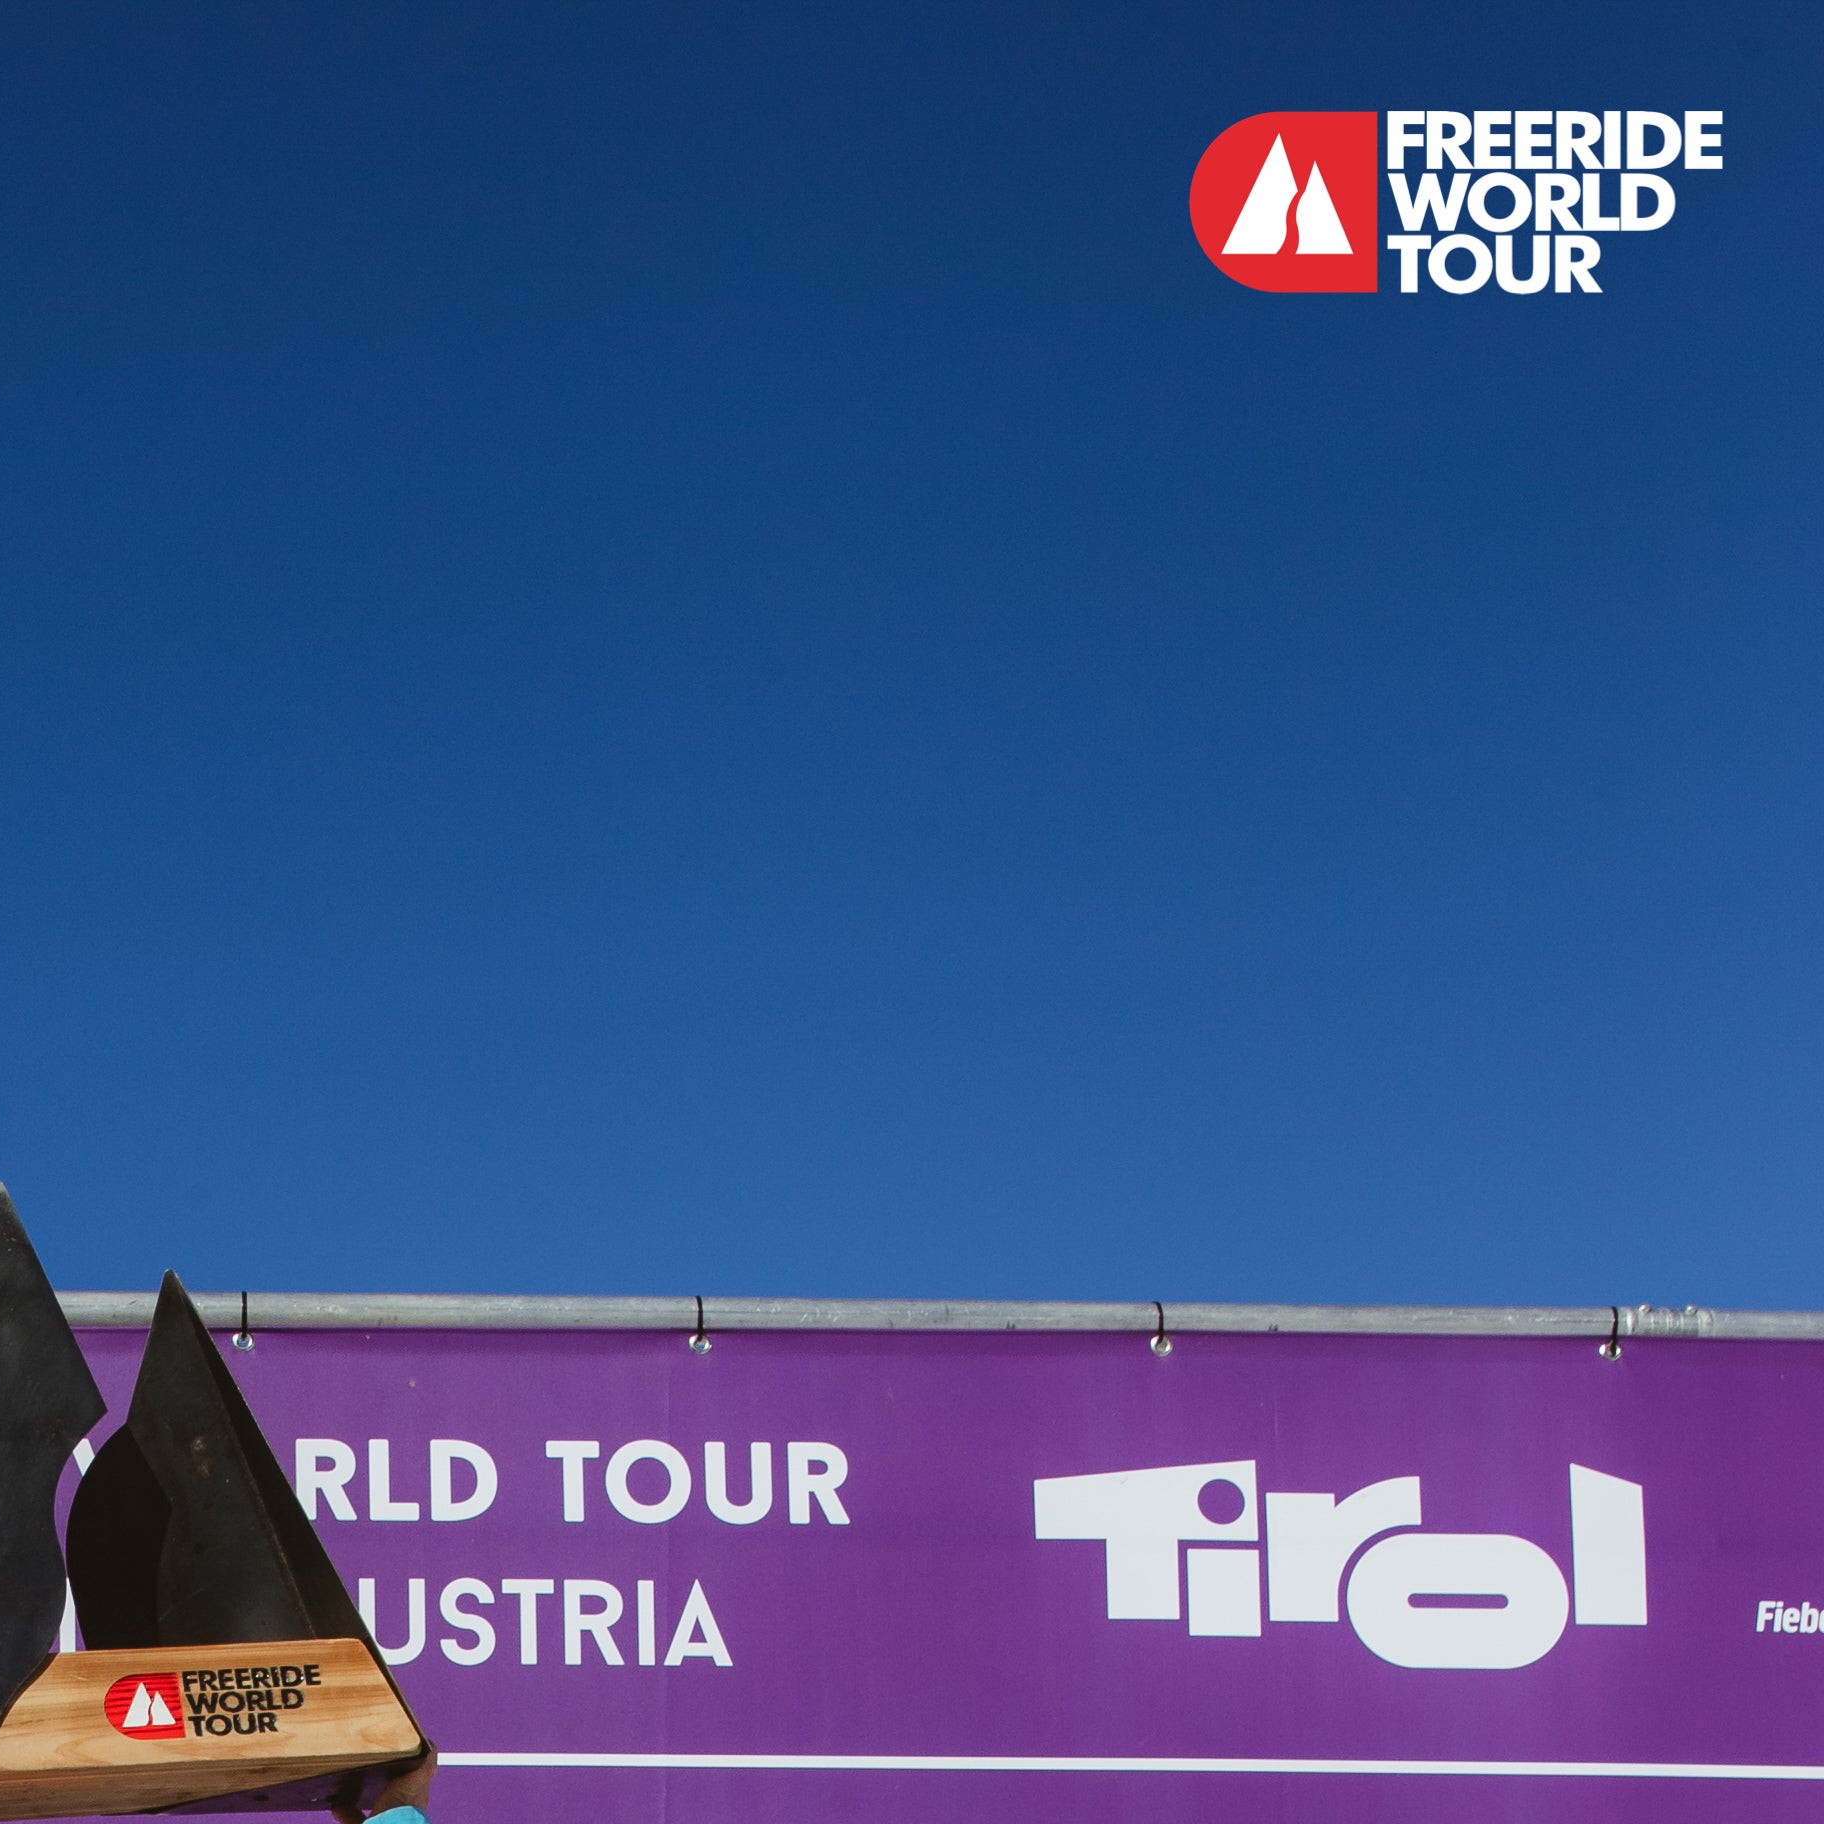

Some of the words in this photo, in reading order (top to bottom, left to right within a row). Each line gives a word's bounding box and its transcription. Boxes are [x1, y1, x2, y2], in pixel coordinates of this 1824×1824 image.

[294, 1438, 499, 1522] RLD
[546, 1440, 851, 1526] TOUR
[358, 1577, 734, 1667] USTRIA
[182, 1664, 322, 1692] FREERIDE
[185, 1686, 304, 1715] WORLD
[188, 1711, 279, 1738] TOUR
